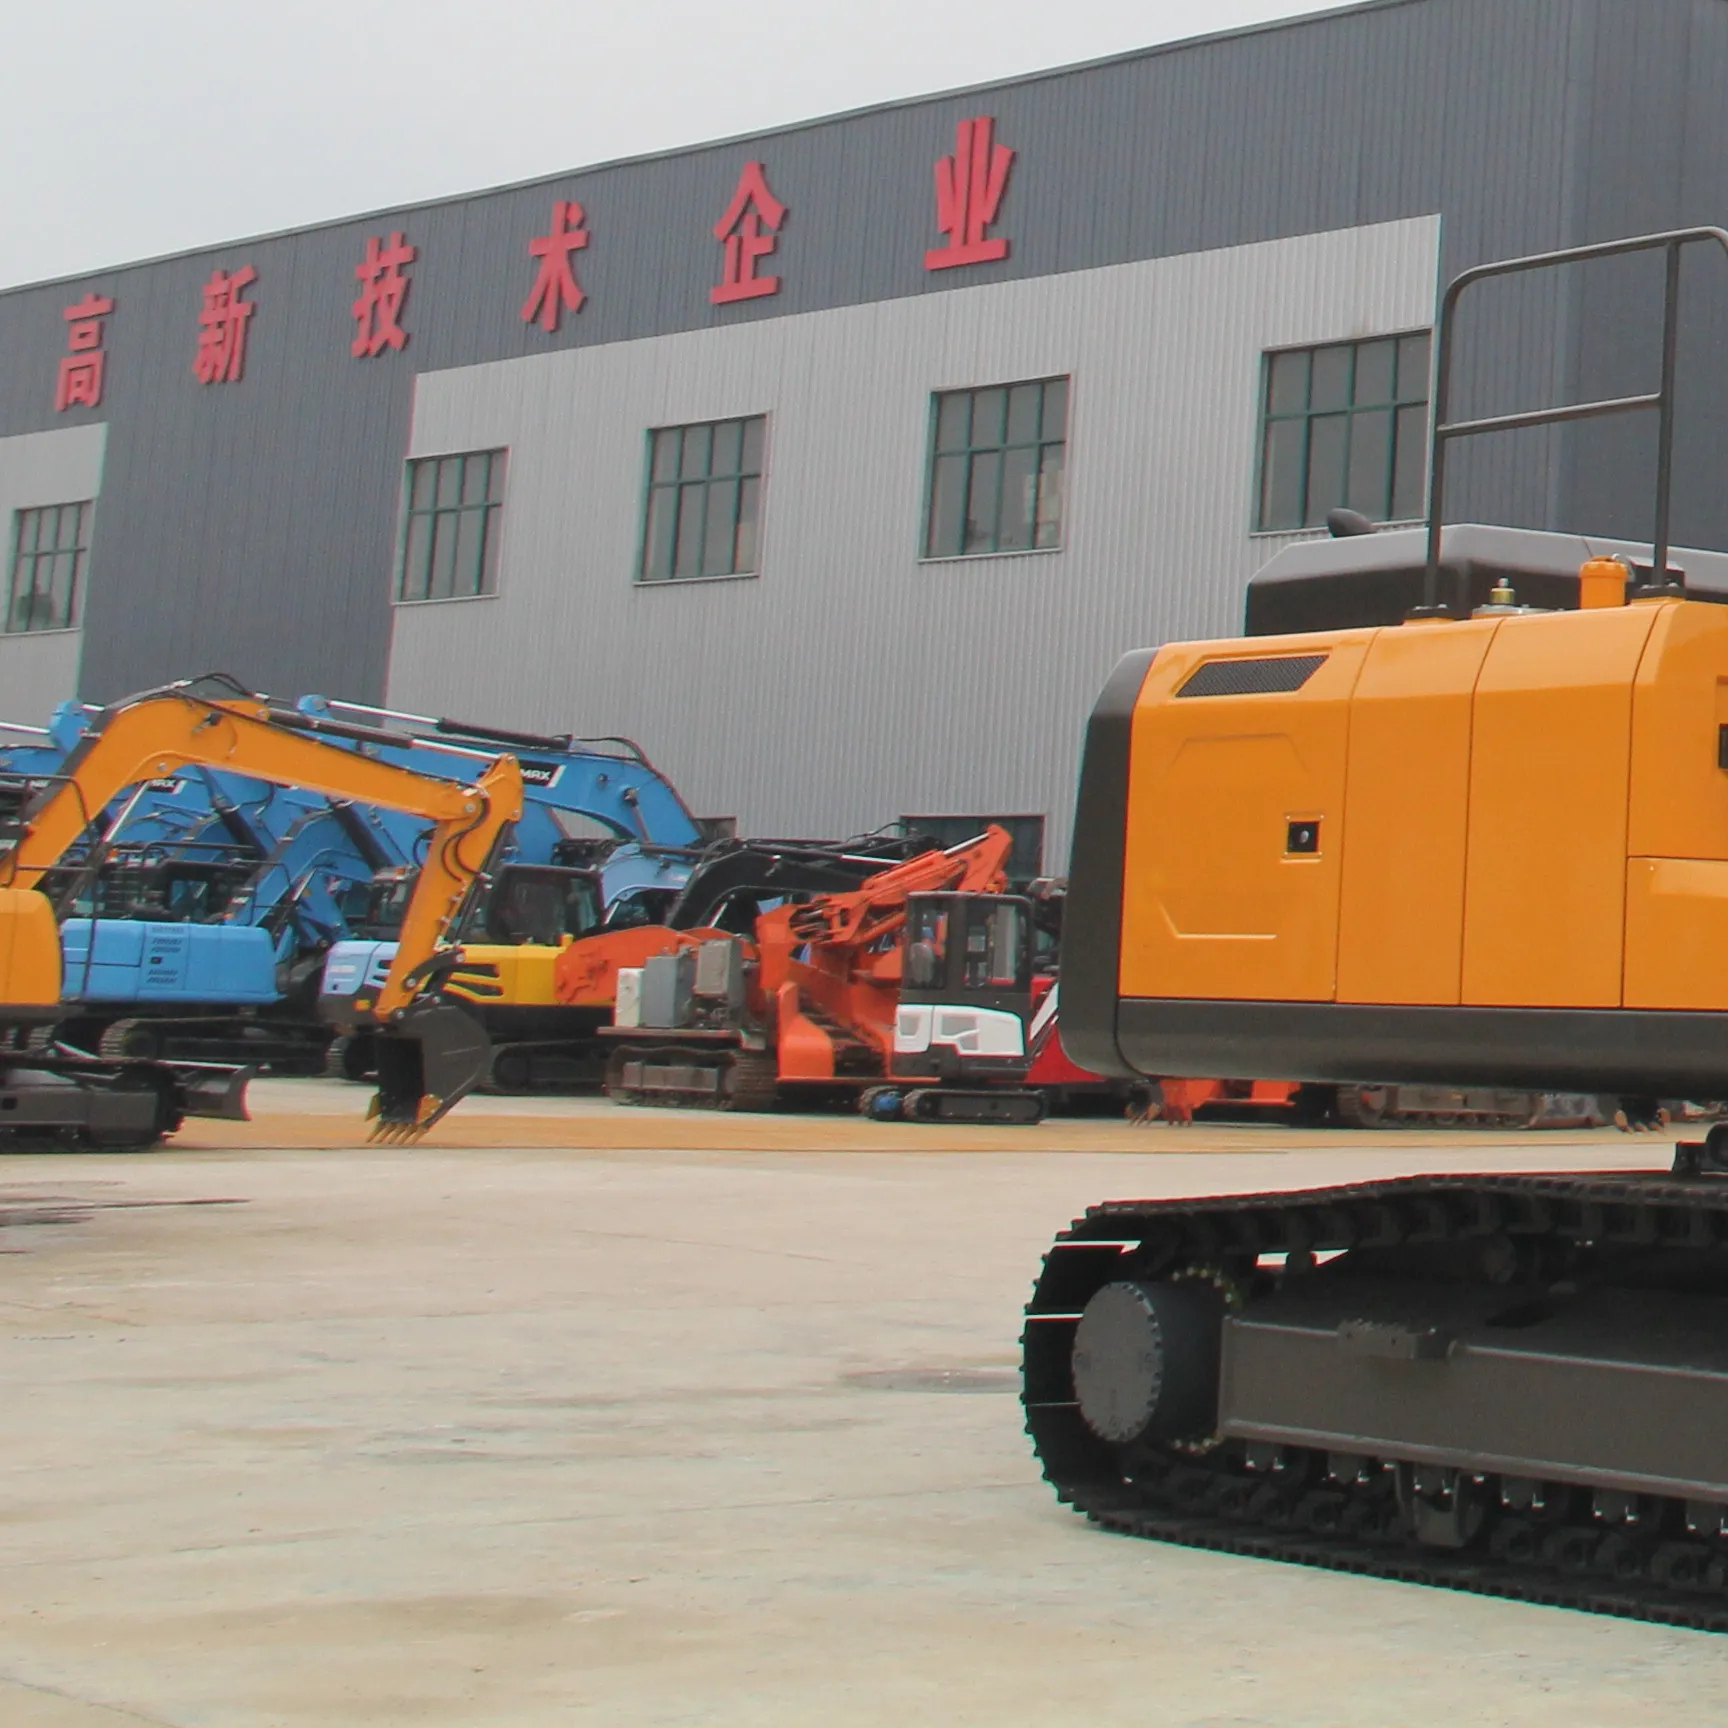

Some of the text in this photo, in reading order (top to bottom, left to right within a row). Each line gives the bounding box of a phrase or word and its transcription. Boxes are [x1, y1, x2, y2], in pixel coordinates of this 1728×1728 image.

[54, 114, 1015, 412] 高新技术企业
